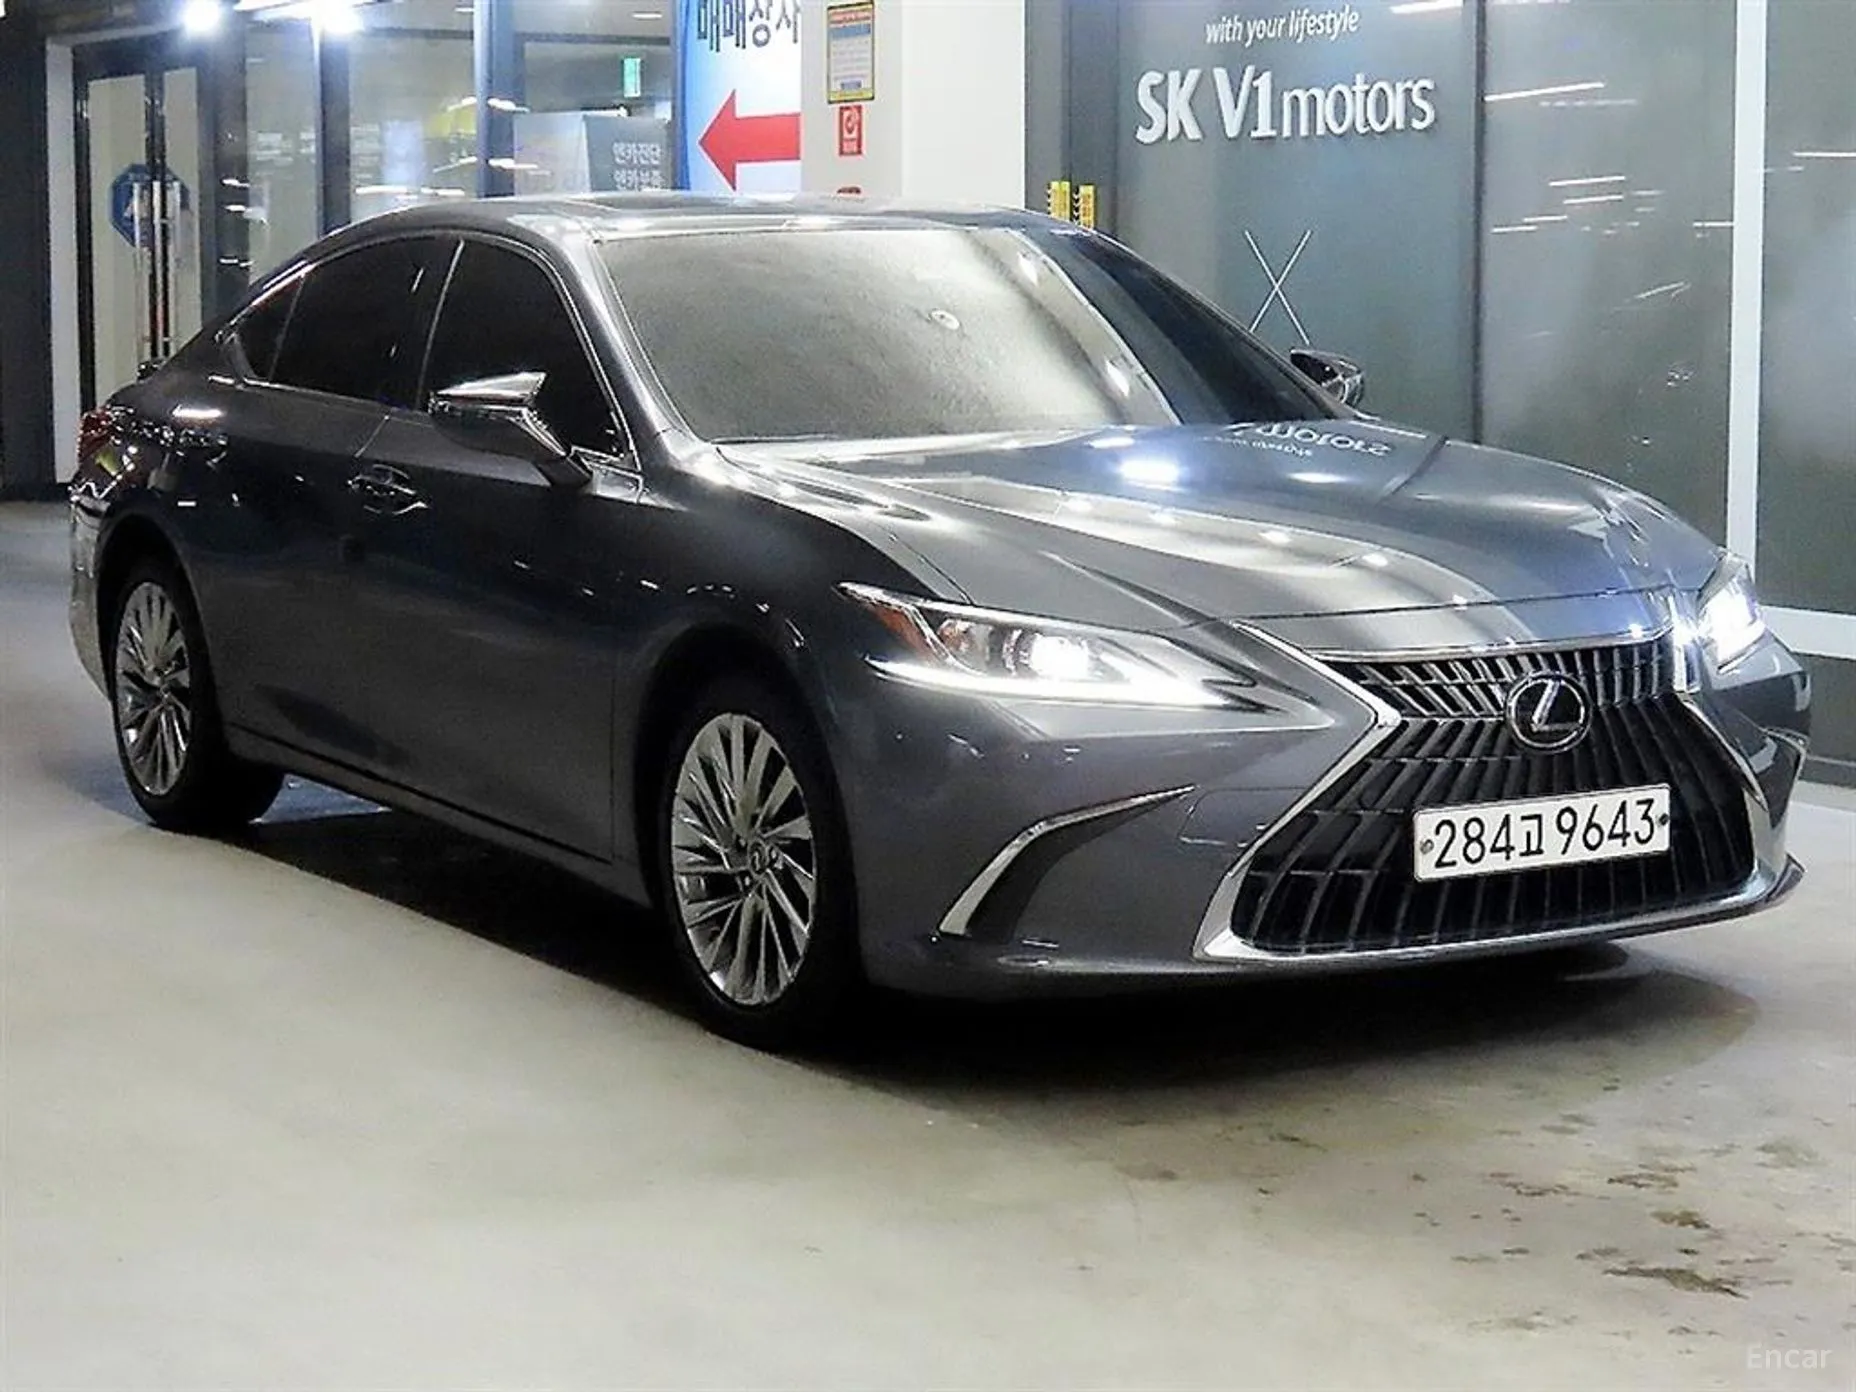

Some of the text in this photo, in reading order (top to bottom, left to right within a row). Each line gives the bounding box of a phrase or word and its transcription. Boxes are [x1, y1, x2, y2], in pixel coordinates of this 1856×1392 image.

[697, 0, 801, 52] 매매상사
[1205, 6, 1360, 47] with your lifestyle
[1136, 69, 1204, 144] SK
[1434, 798, 1655, 869] 284고 9643
